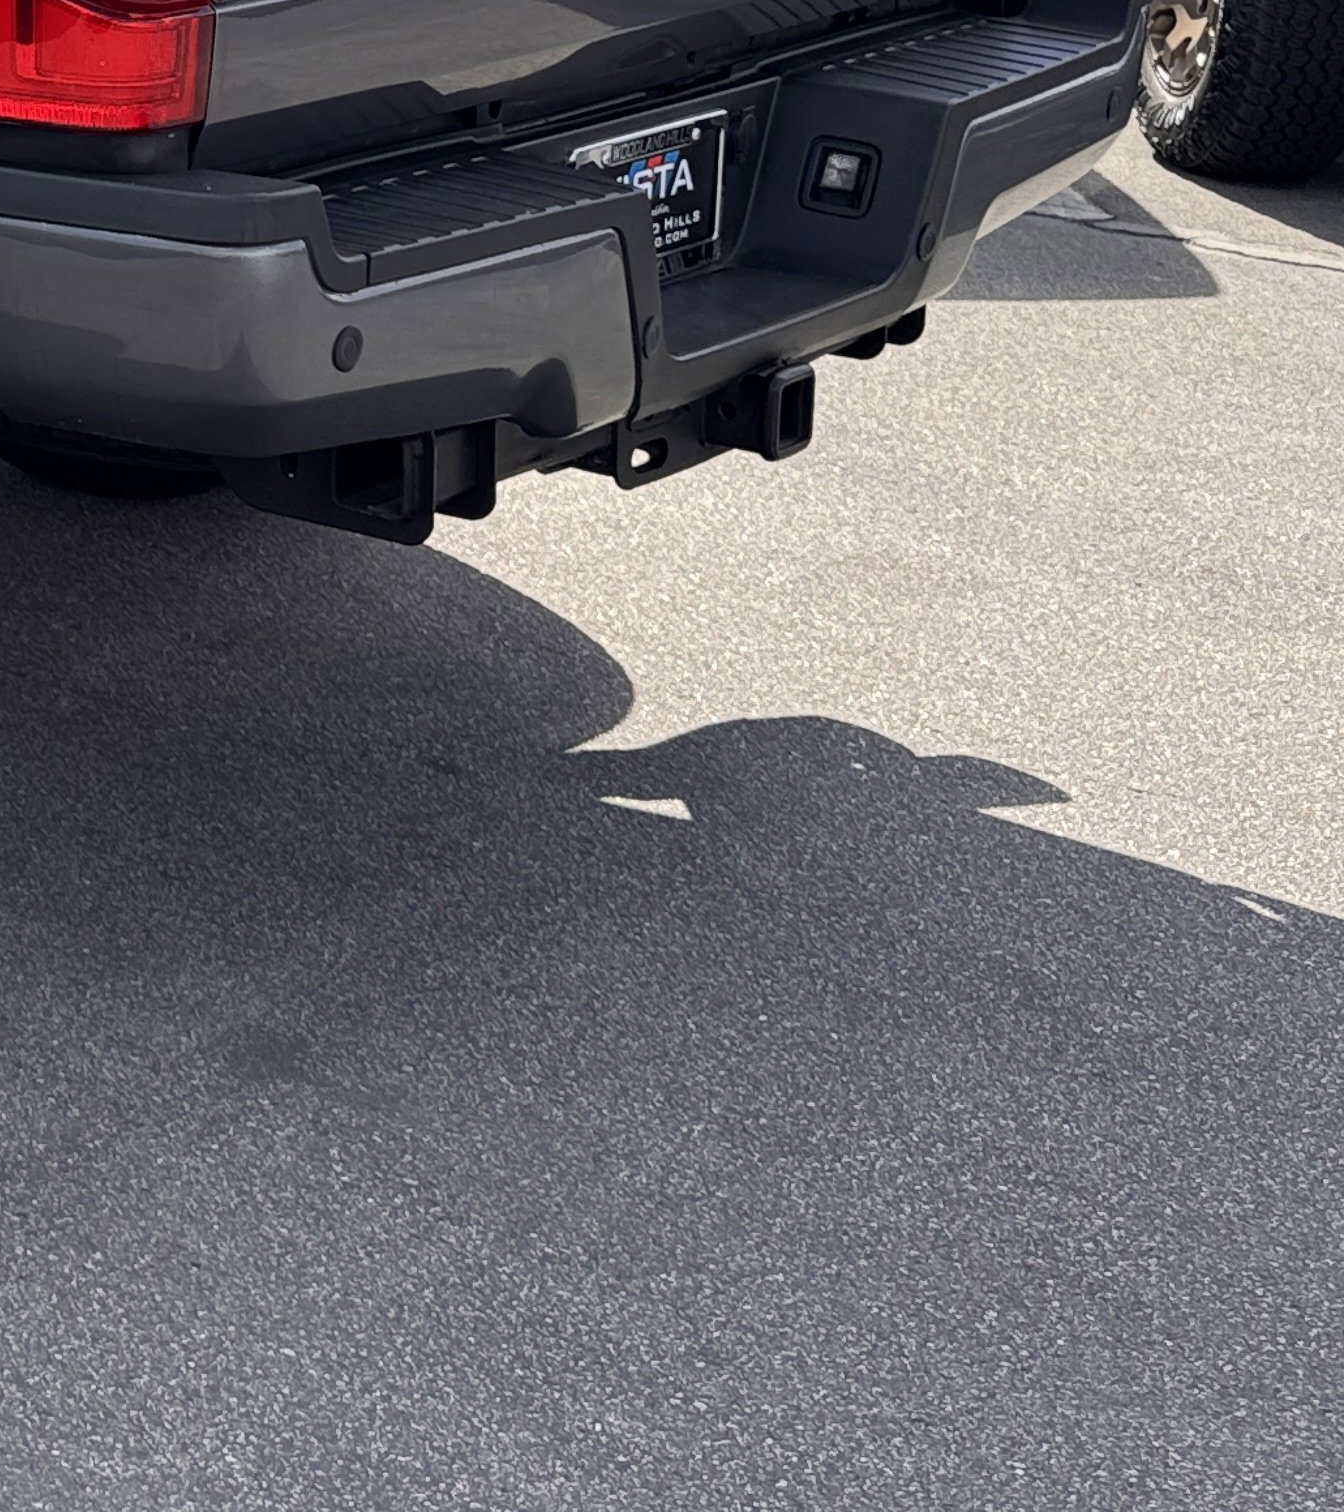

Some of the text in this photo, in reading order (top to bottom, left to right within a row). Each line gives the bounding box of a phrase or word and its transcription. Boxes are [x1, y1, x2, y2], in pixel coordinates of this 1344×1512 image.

[613, 125, 693, 162] WOODLAND HILLS
[664, 209, 701, 231] HILLS
